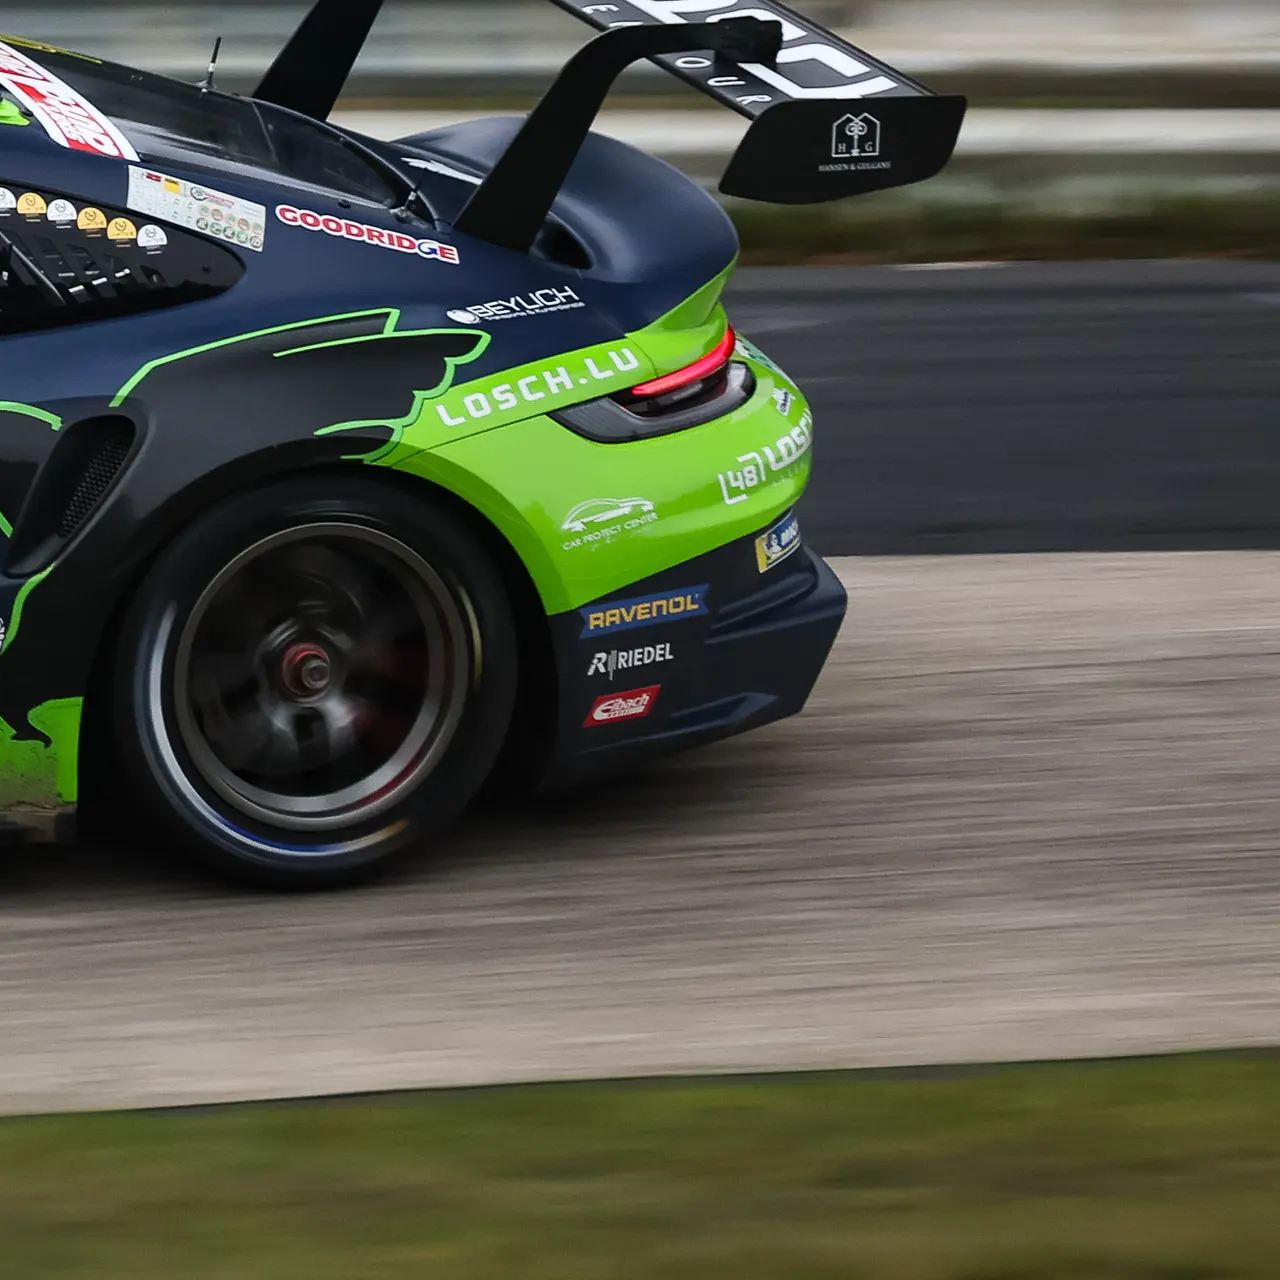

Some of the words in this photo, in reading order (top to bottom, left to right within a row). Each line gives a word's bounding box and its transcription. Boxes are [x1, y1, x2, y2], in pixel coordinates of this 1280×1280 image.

[280, 205, 458, 261] GOODRIDGE
[466, 286, 580, 317] BEYLICH
[434, 346, 639, 427] LOSCH.LU
[589, 595, 697, 631] RAVENOL
[616, 643, 674, 670] RIEDEL
[592, 692, 651, 721] Eibach
